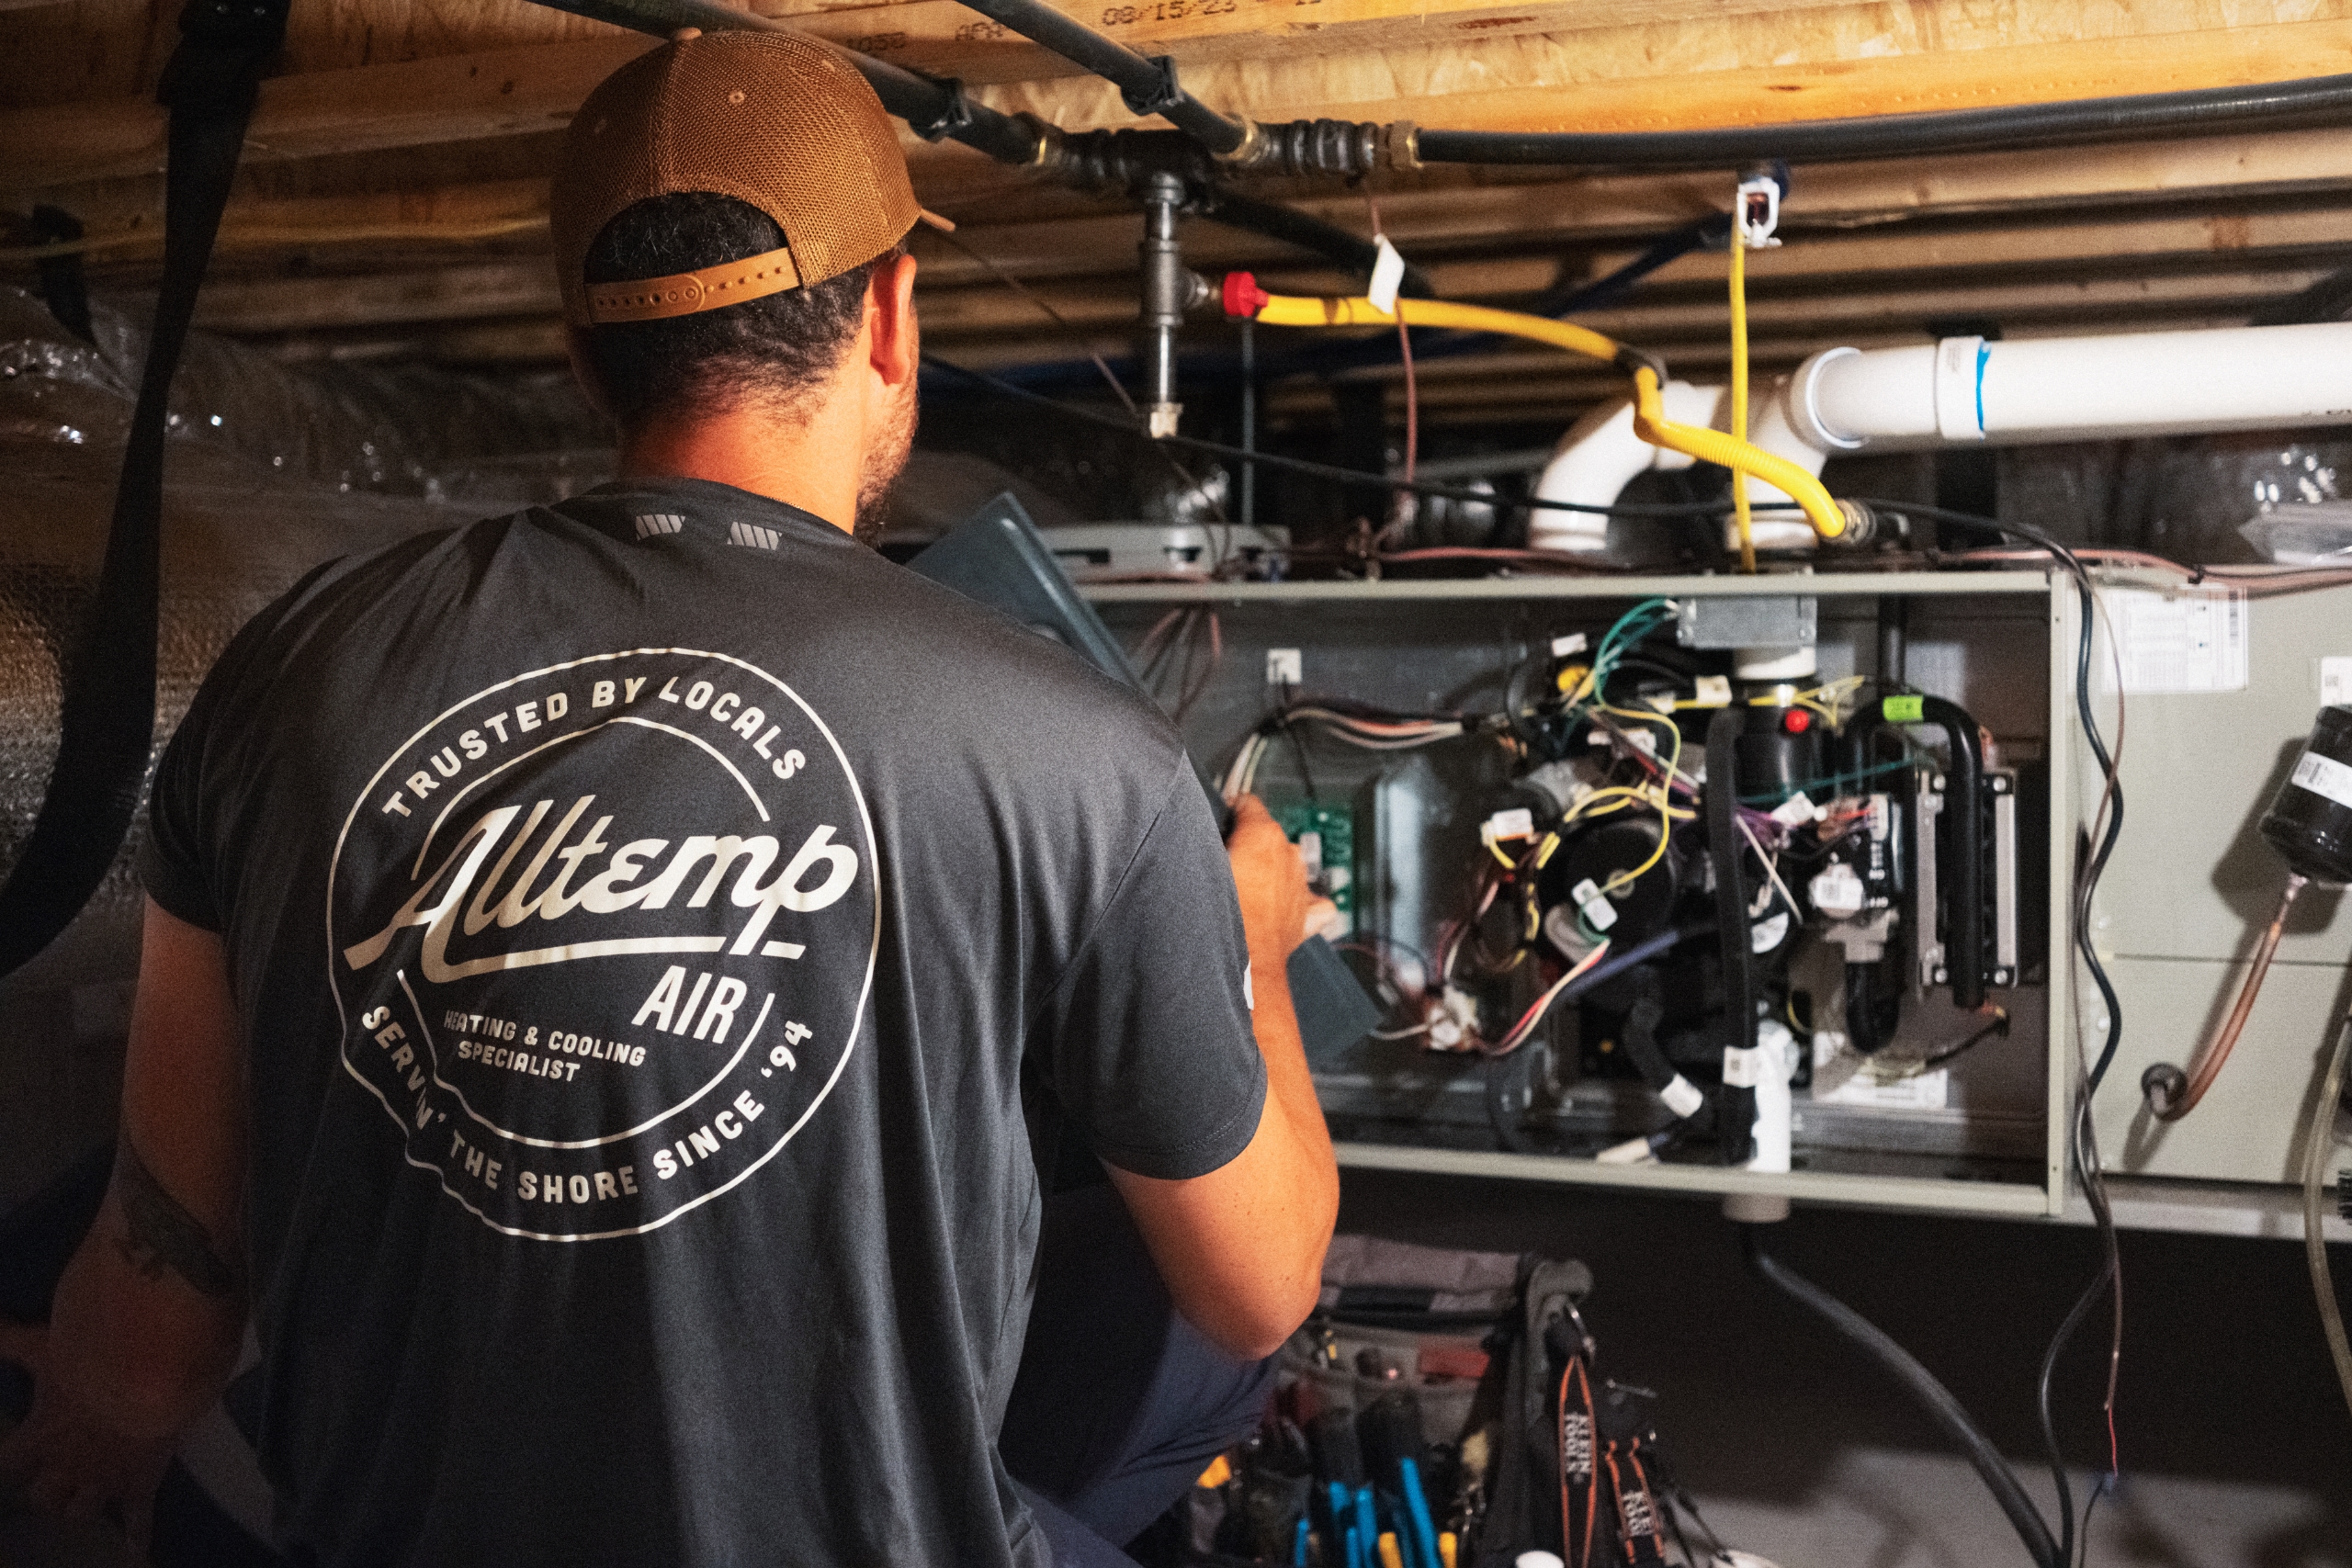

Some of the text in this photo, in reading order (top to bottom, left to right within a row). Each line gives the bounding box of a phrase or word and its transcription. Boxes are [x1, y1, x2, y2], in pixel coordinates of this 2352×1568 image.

[382, 676, 807, 819] TRUSTED BY LOCALS
[343, 795, 859, 984] Alltemp
[444, 1010, 647, 1067] HEATING & COOLING
[631, 965, 748, 1043] AIR
[458, 1041, 582, 1082] SPECIALIST
[449, 1130, 503, 1190] THE
[517, 1165, 639, 1204] SHORE
[652, 1089, 766, 1180] SINCE
